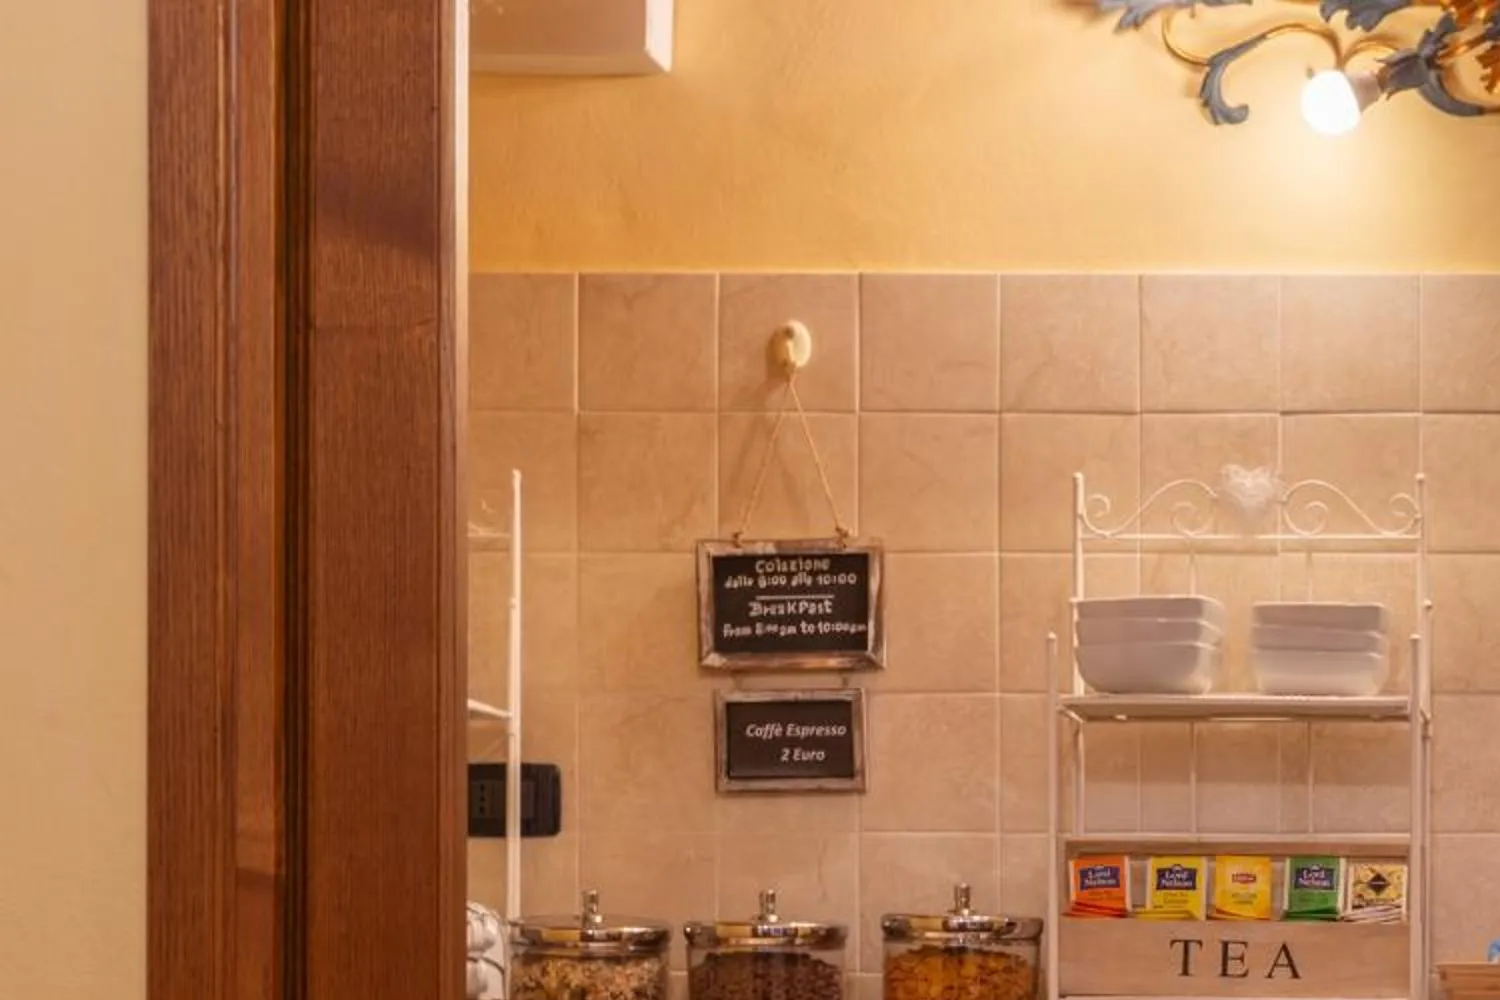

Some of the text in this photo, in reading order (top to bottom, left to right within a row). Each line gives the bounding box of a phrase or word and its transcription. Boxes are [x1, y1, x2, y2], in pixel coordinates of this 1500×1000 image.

[816, 573, 857, 585] 10:00
[800, 620, 814, 634] to
[745, 722, 847, 740] Caffè Espresso
[781, 748, 826, 762] 2 Euro
[1169, 939, 1302, 979] TEA
